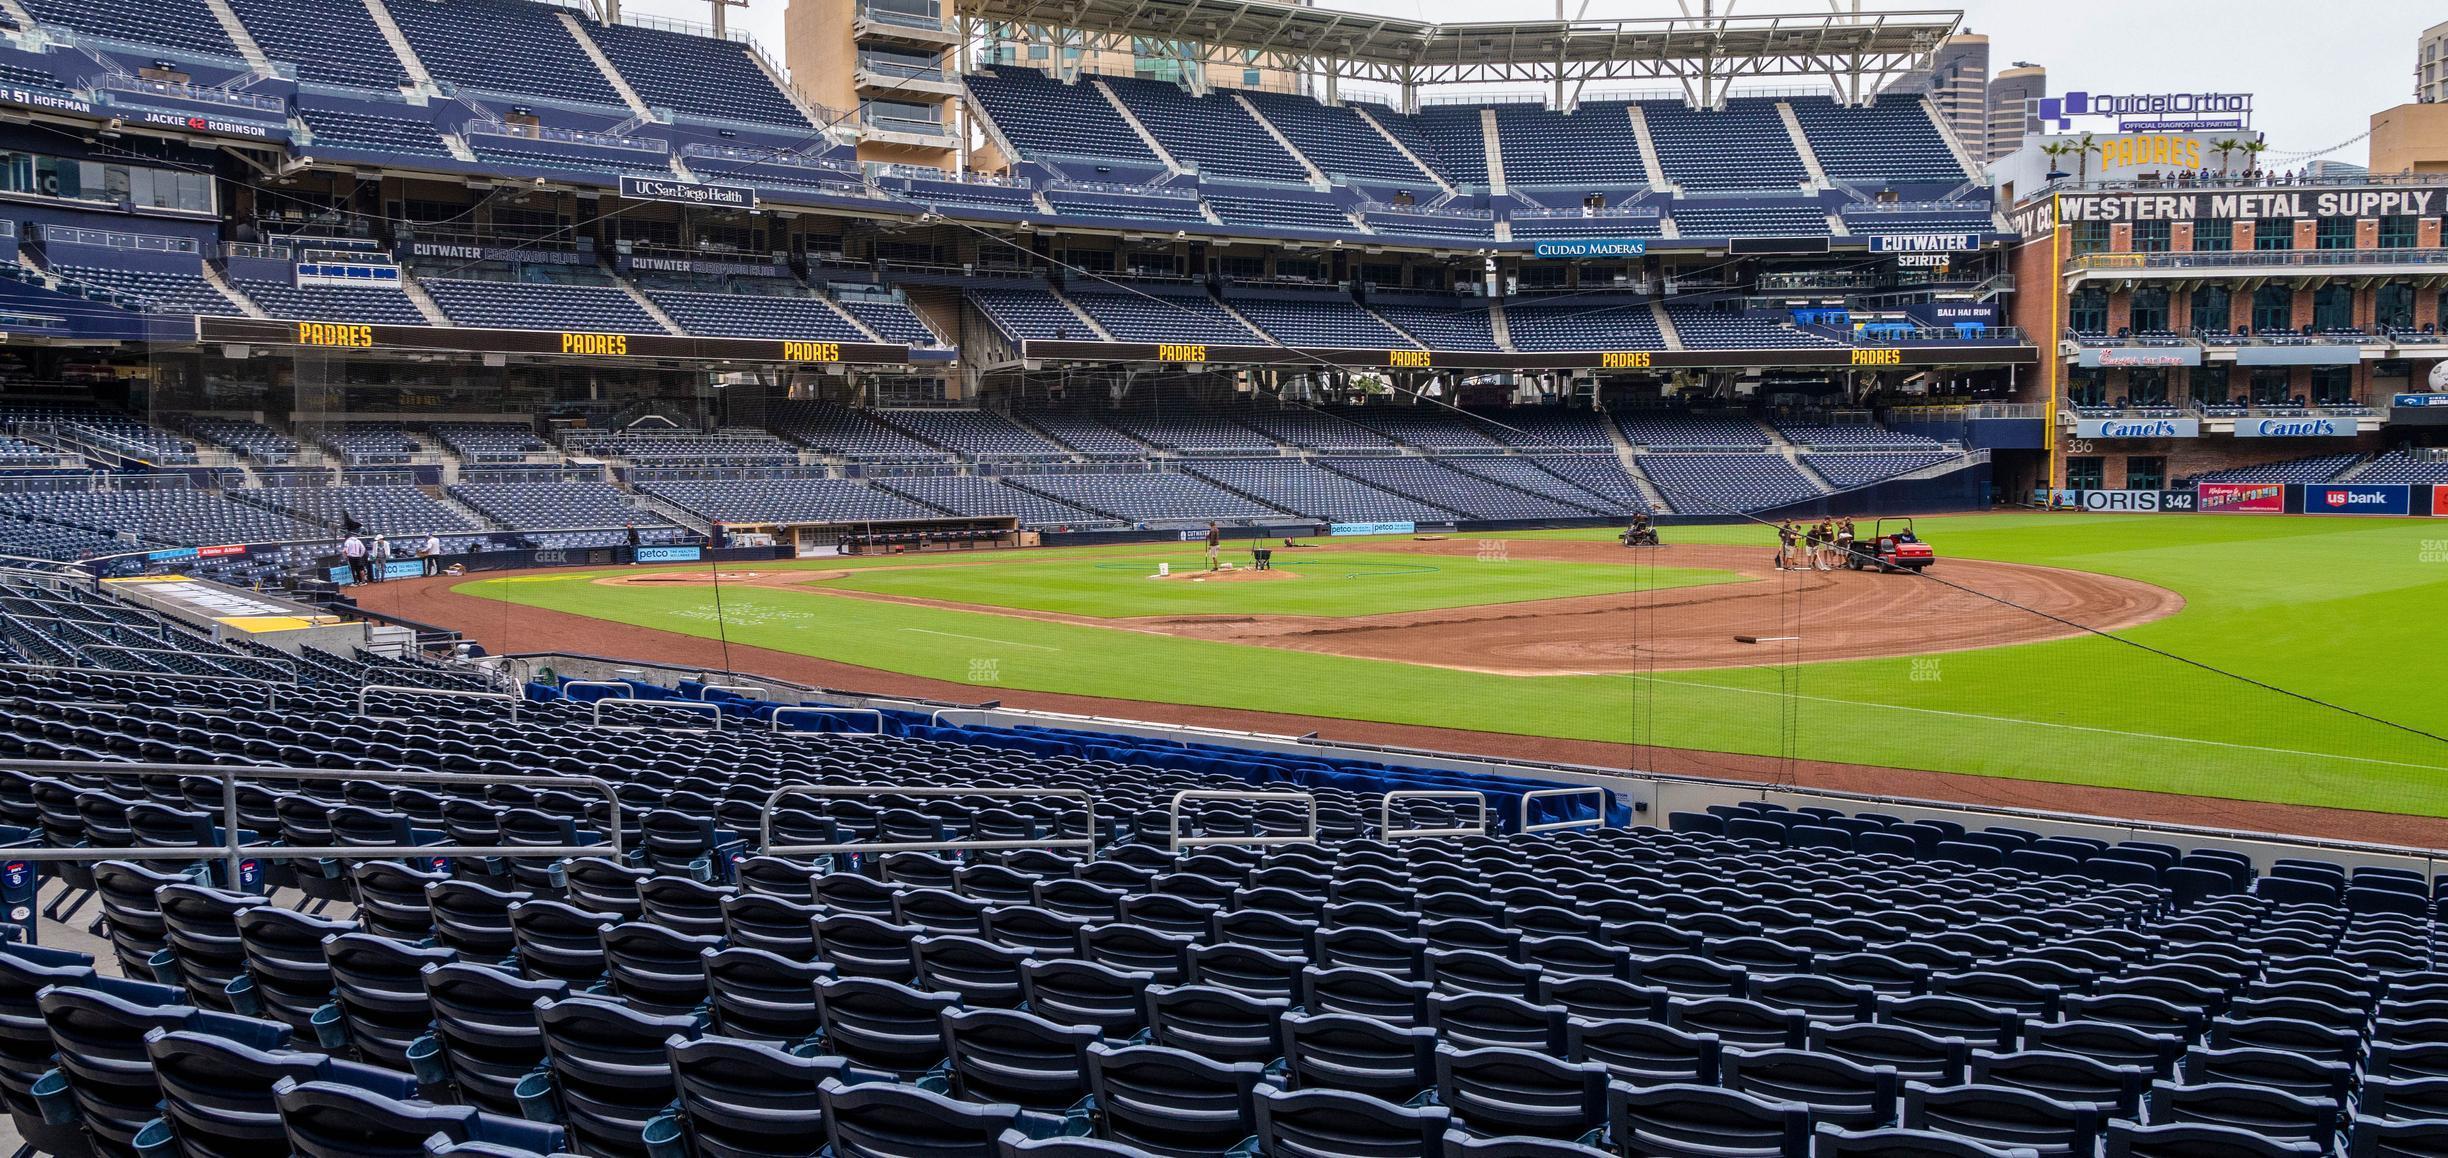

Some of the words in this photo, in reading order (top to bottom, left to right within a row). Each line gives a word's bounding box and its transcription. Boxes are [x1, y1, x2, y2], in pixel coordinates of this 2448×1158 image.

[14, 91, 30, 104] 51
[34, 95, 90, 113] HOFFMAN
[2095, 93, 2243, 117] QuidelOrtho
[145, 113, 185, 127] JACKIE
[188, 118, 207, 129] 42
[208, 122, 266, 137] ROBINSON
[2157, 121, 2204, 129] DIAGNOSTICS
[2206, 120, 2238, 128] PARTNER
[2101, 136, 2200, 172] PADRES
[635, 181, 654, 195] UC
[677, 185, 708, 202] Diego
[708, 188, 743, 203] Health
[2059, 196, 2196, 221] WESTERN
[2211, 193, 2309, 218] METAL
[2317, 191, 2433, 217] SUPPLY
[414, 244, 481, 258] CUTWATER
[1538, 245, 1585, 255] CIUDAD
[1589, 244, 1643, 254] MADERAS
[1882, 235, 1967, 251] CUTWATER
[632, 258, 690, 272] CUTWATER
[1898, 254, 1950, 266] SPIRITS
[299, 322, 372, 347] PADRES
[562, 333, 626, 355] PADRES
[784, 342, 839, 361] PADRES
[1159, 345, 1205, 361] PADRES
[1390, 351, 1430, 366] PADRES
[1603, 353, 1650, 367] PADRES
[1852, 350, 1900, 364] PADRES
[2100, 421, 2176, 437] Canel's
[2258, 420, 2335, 436] Canel's
[2067, 440, 2093, 453] 336
[2087, 492, 2156, 510] ORIS
[2165, 494, 2192, 509] 342
[1332, 525, 1352, 535] petco
[1375, 523, 1394, 533] petco
[639, 549, 668, 561] petco
